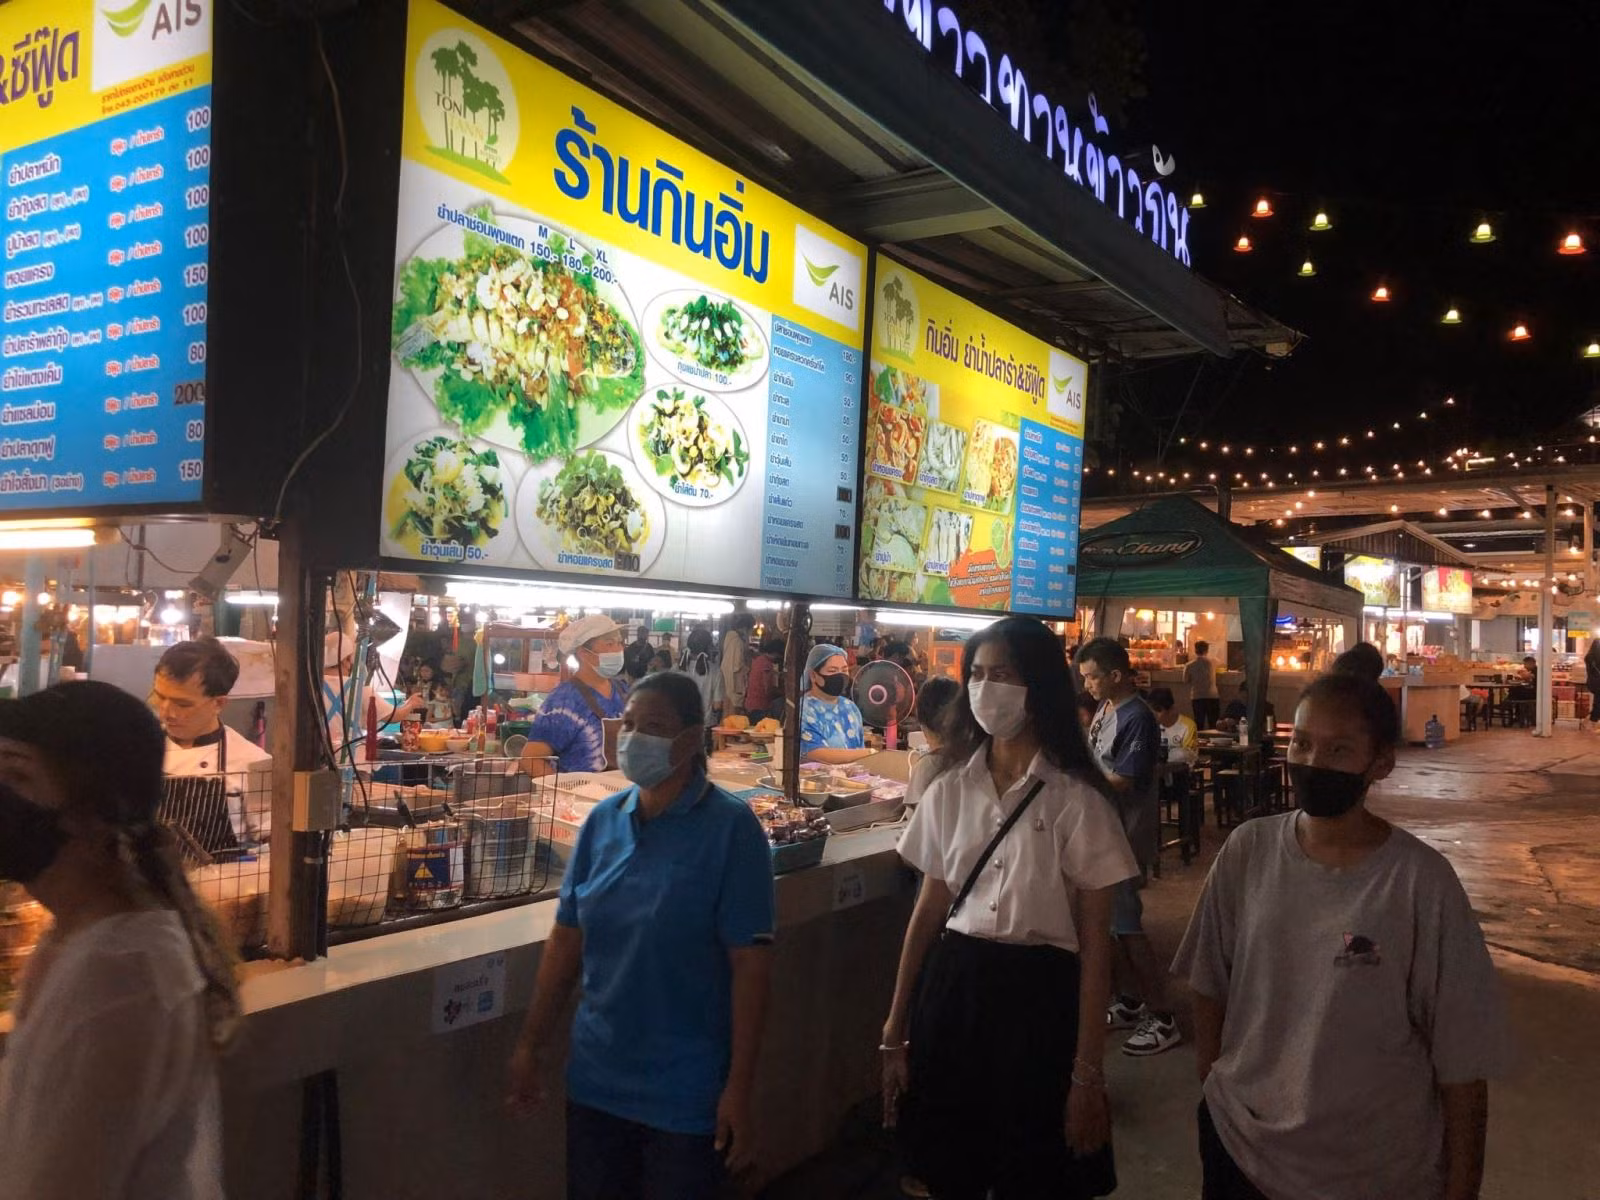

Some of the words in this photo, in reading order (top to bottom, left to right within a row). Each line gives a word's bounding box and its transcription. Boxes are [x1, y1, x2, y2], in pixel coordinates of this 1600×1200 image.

[151, 0, 202, 40] AIS
[435, 91, 462, 117] TON
[9, 155, 60, 184] ยำปลาหมึก
[188, 109, 209, 130] 100
[187, 148, 208, 169] 100
[187, 187, 208, 208] 100
[553, 104, 770, 285] ร้านกินอิ่ม
[437, 204, 525, 250] ยำปลาช่อนพุงแตก
[530, 241, 558, 262] 150.-
[562, 254, 589, 274] 180.-
[593, 265, 618, 285] 200.-
[538, 225, 548, 239] M
[569, 237, 576, 251] L
[595, 248, 608, 264] XL
[6, 264, 53, 286] หอยแครง
[186, 226, 207, 247] 100
[185, 265, 207, 286] 150
[829, 281, 854, 311] AIS
[184, 304, 206, 324] 100
[925, 318, 959, 363] กินอิ่ม
[3, 365, 61, 389] ยำไข่แดงเค็ม
[190, 343, 205, 361] 80
[714, 373, 732, 386] 100.-
[1066, 390, 1081, 410] AIS
[188, 423, 203, 440] 80
[180, 461, 202, 480] 150
[421, 541, 463, 561] ยำวุ้นเส้น
[466, 546, 488, 560] 50.-
[1117, 540, 1195, 555] Chang
[557, 551, 613, 569] ยำหอยแครงสด
